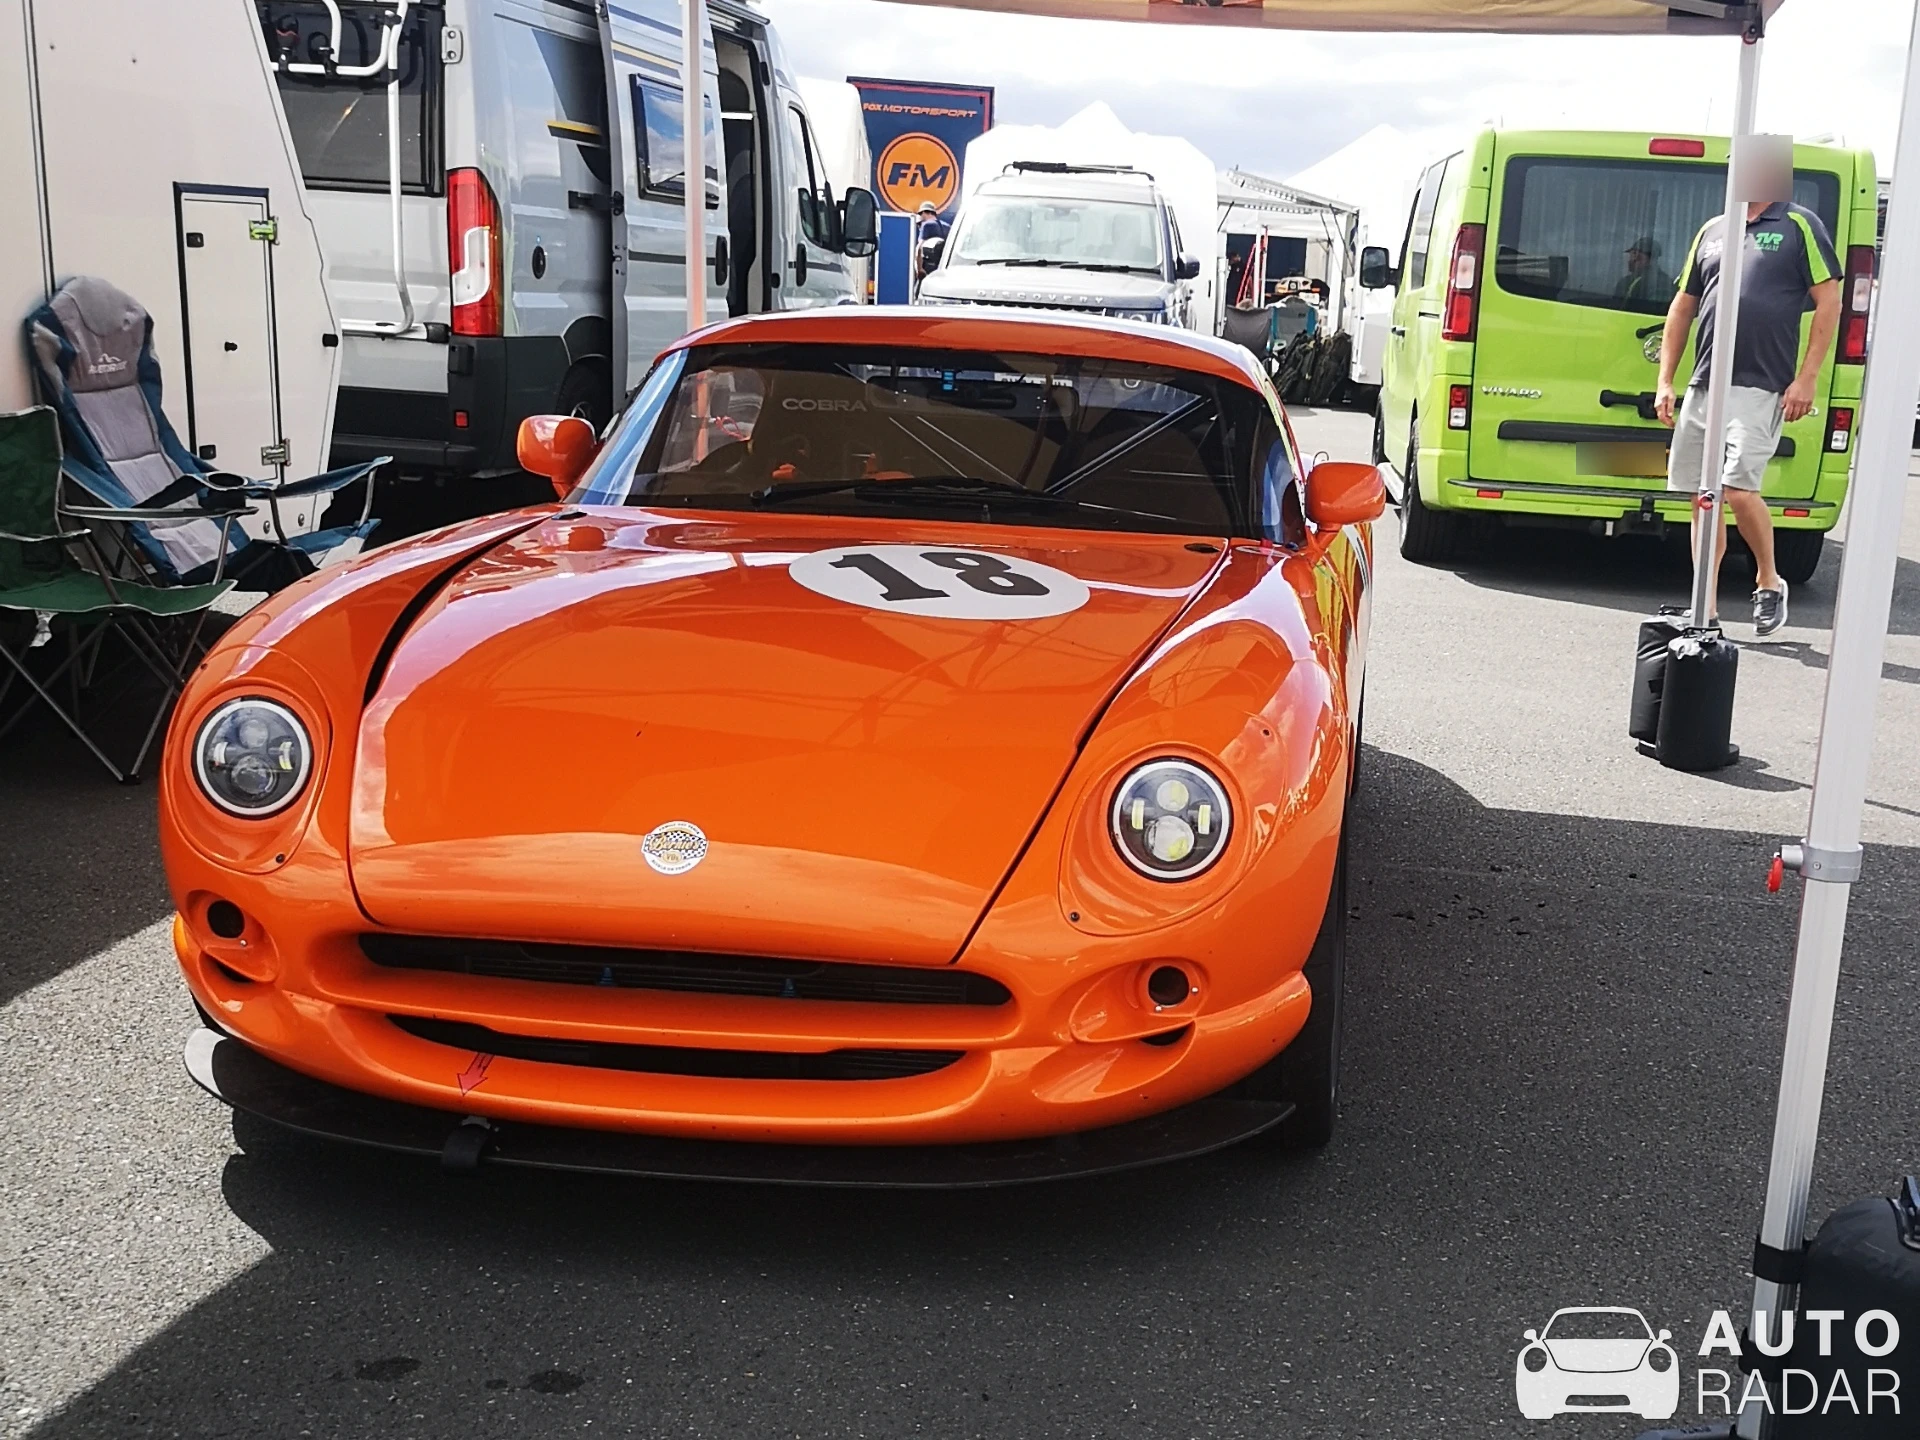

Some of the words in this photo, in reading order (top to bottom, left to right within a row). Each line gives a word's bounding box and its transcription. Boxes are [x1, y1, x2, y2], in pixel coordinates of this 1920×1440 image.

[863, 102, 882, 112] FOX
[882, 104, 978, 118] MOTORSPORT
[1755, 232, 1784, 245] TVR
[976, 289, 1103, 304] DISCOVERY
[1481, 385, 1542, 399] VIVARO
[782, 398, 868, 412] COBRA
[828, 551, 1051, 602] 18
